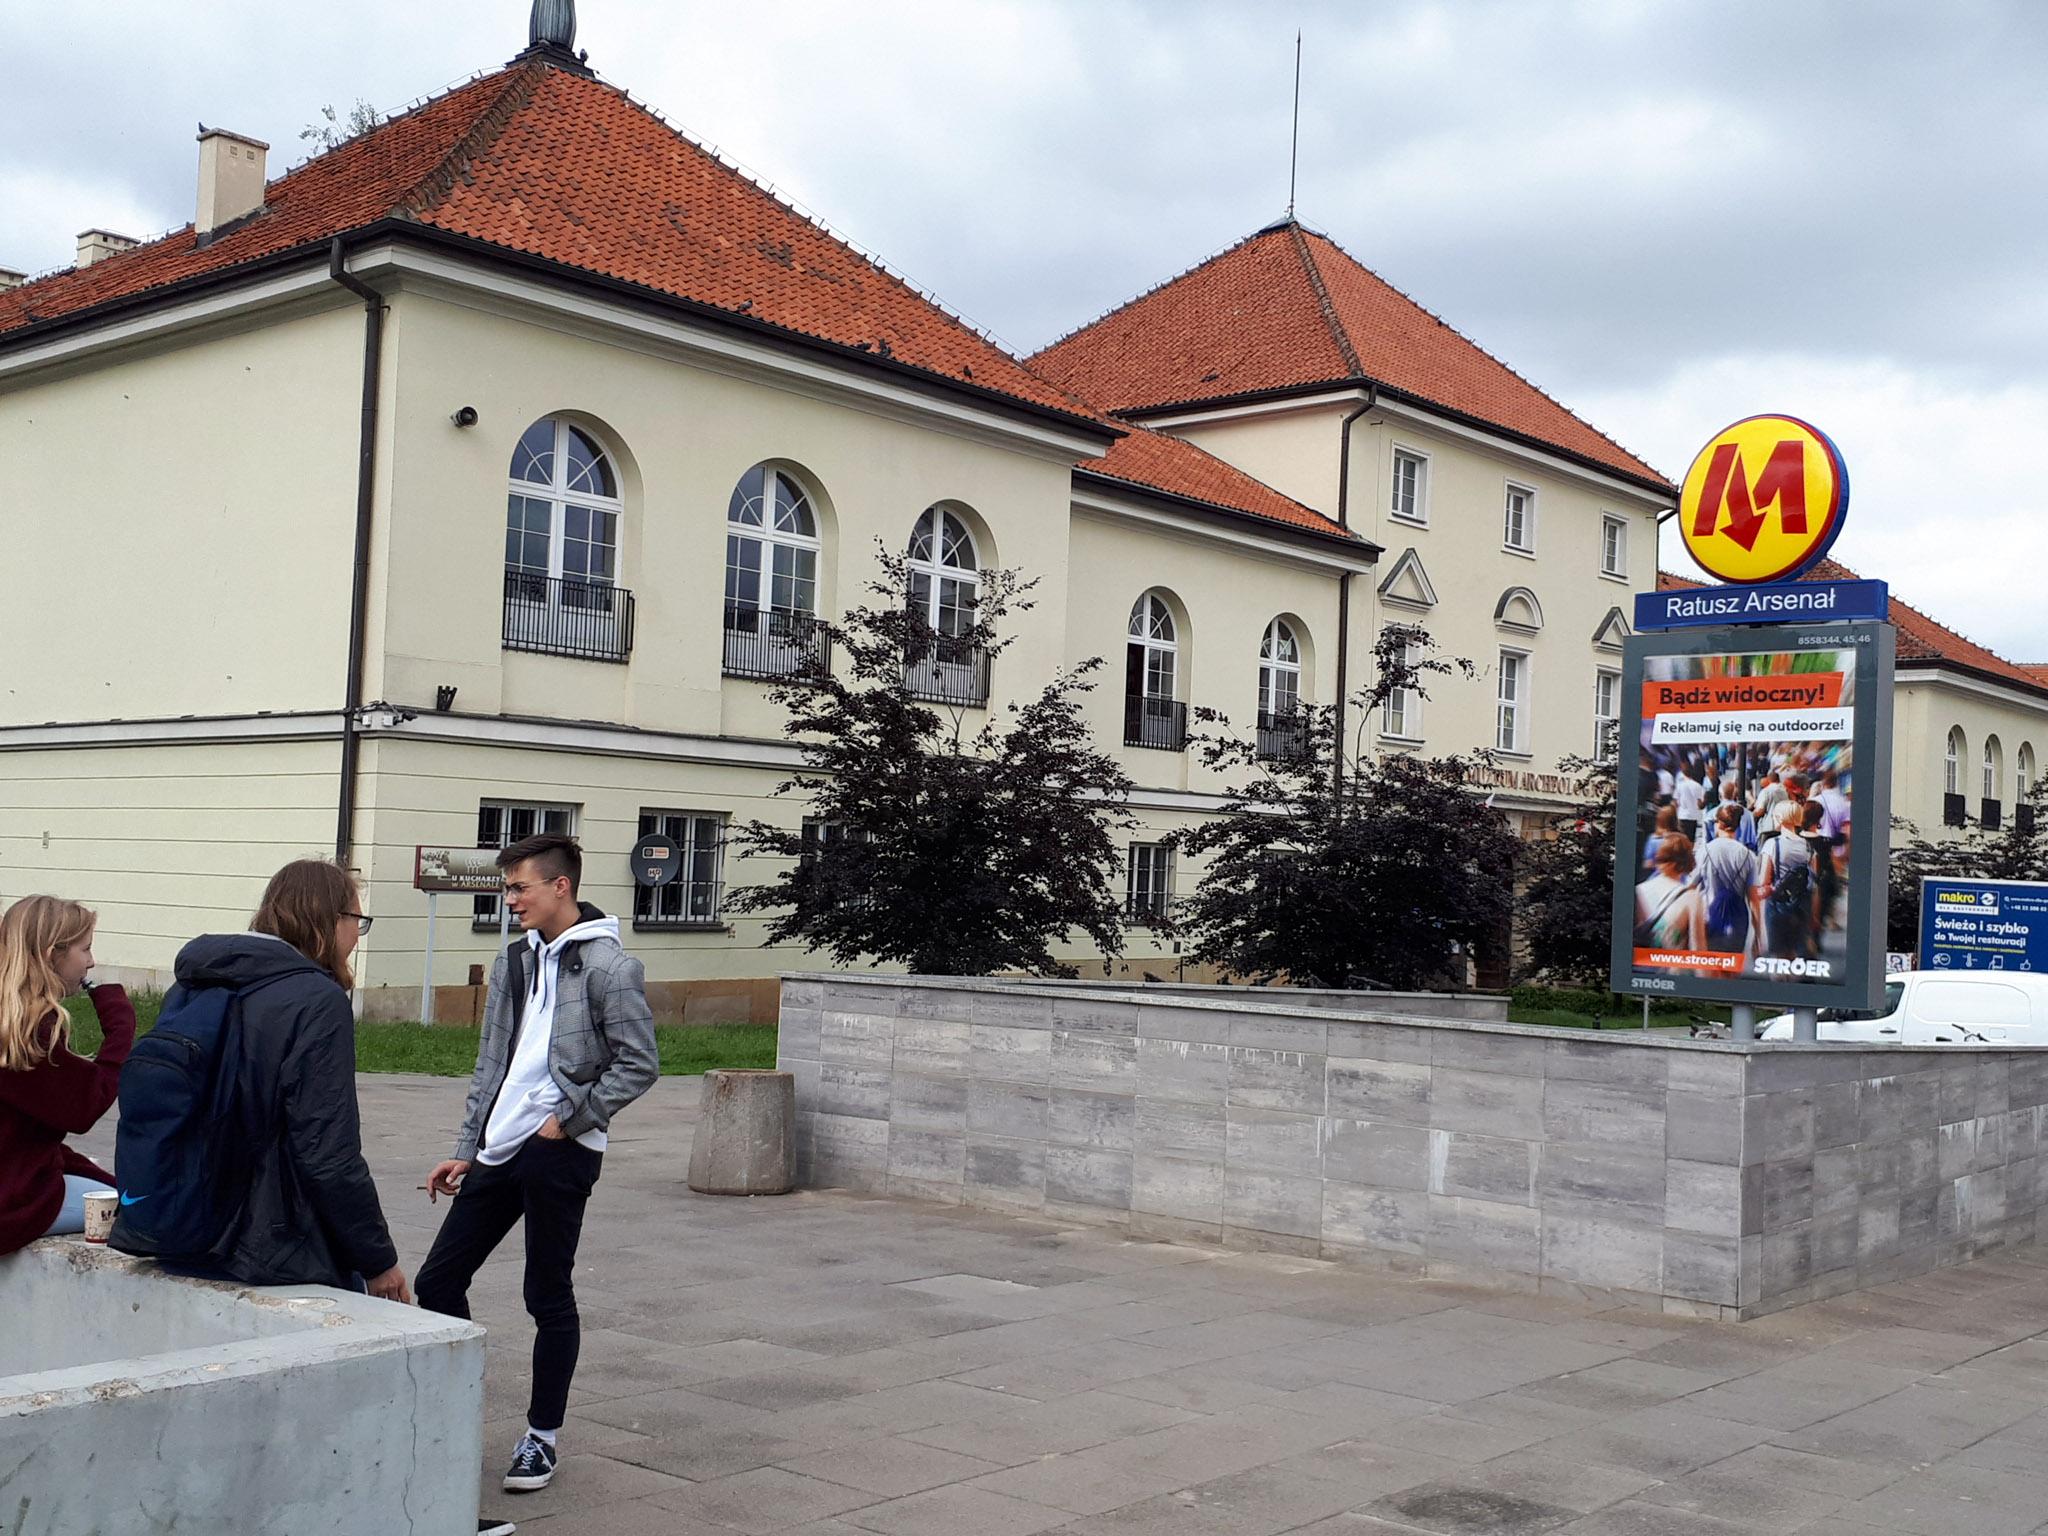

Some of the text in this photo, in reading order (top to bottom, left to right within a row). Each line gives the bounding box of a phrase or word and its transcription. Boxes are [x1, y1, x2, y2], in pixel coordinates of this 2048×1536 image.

[1666, 587, 1836, 618] Ratusz Arsenał
[1859, 634, 1871, 643] 46
[1659, 683, 1825, 709] Bądź widoczny!
[1660, 718, 1844, 735] Reklamuj się na outdoorze!
[1939, 892, 1975, 904] makro
[1934, 915, 2029, 935] Świeżo i szybko
[1934, 932, 2026, 948] do Twojej restauracji
[1650, 953, 1735, 968] www.stroer.pl
